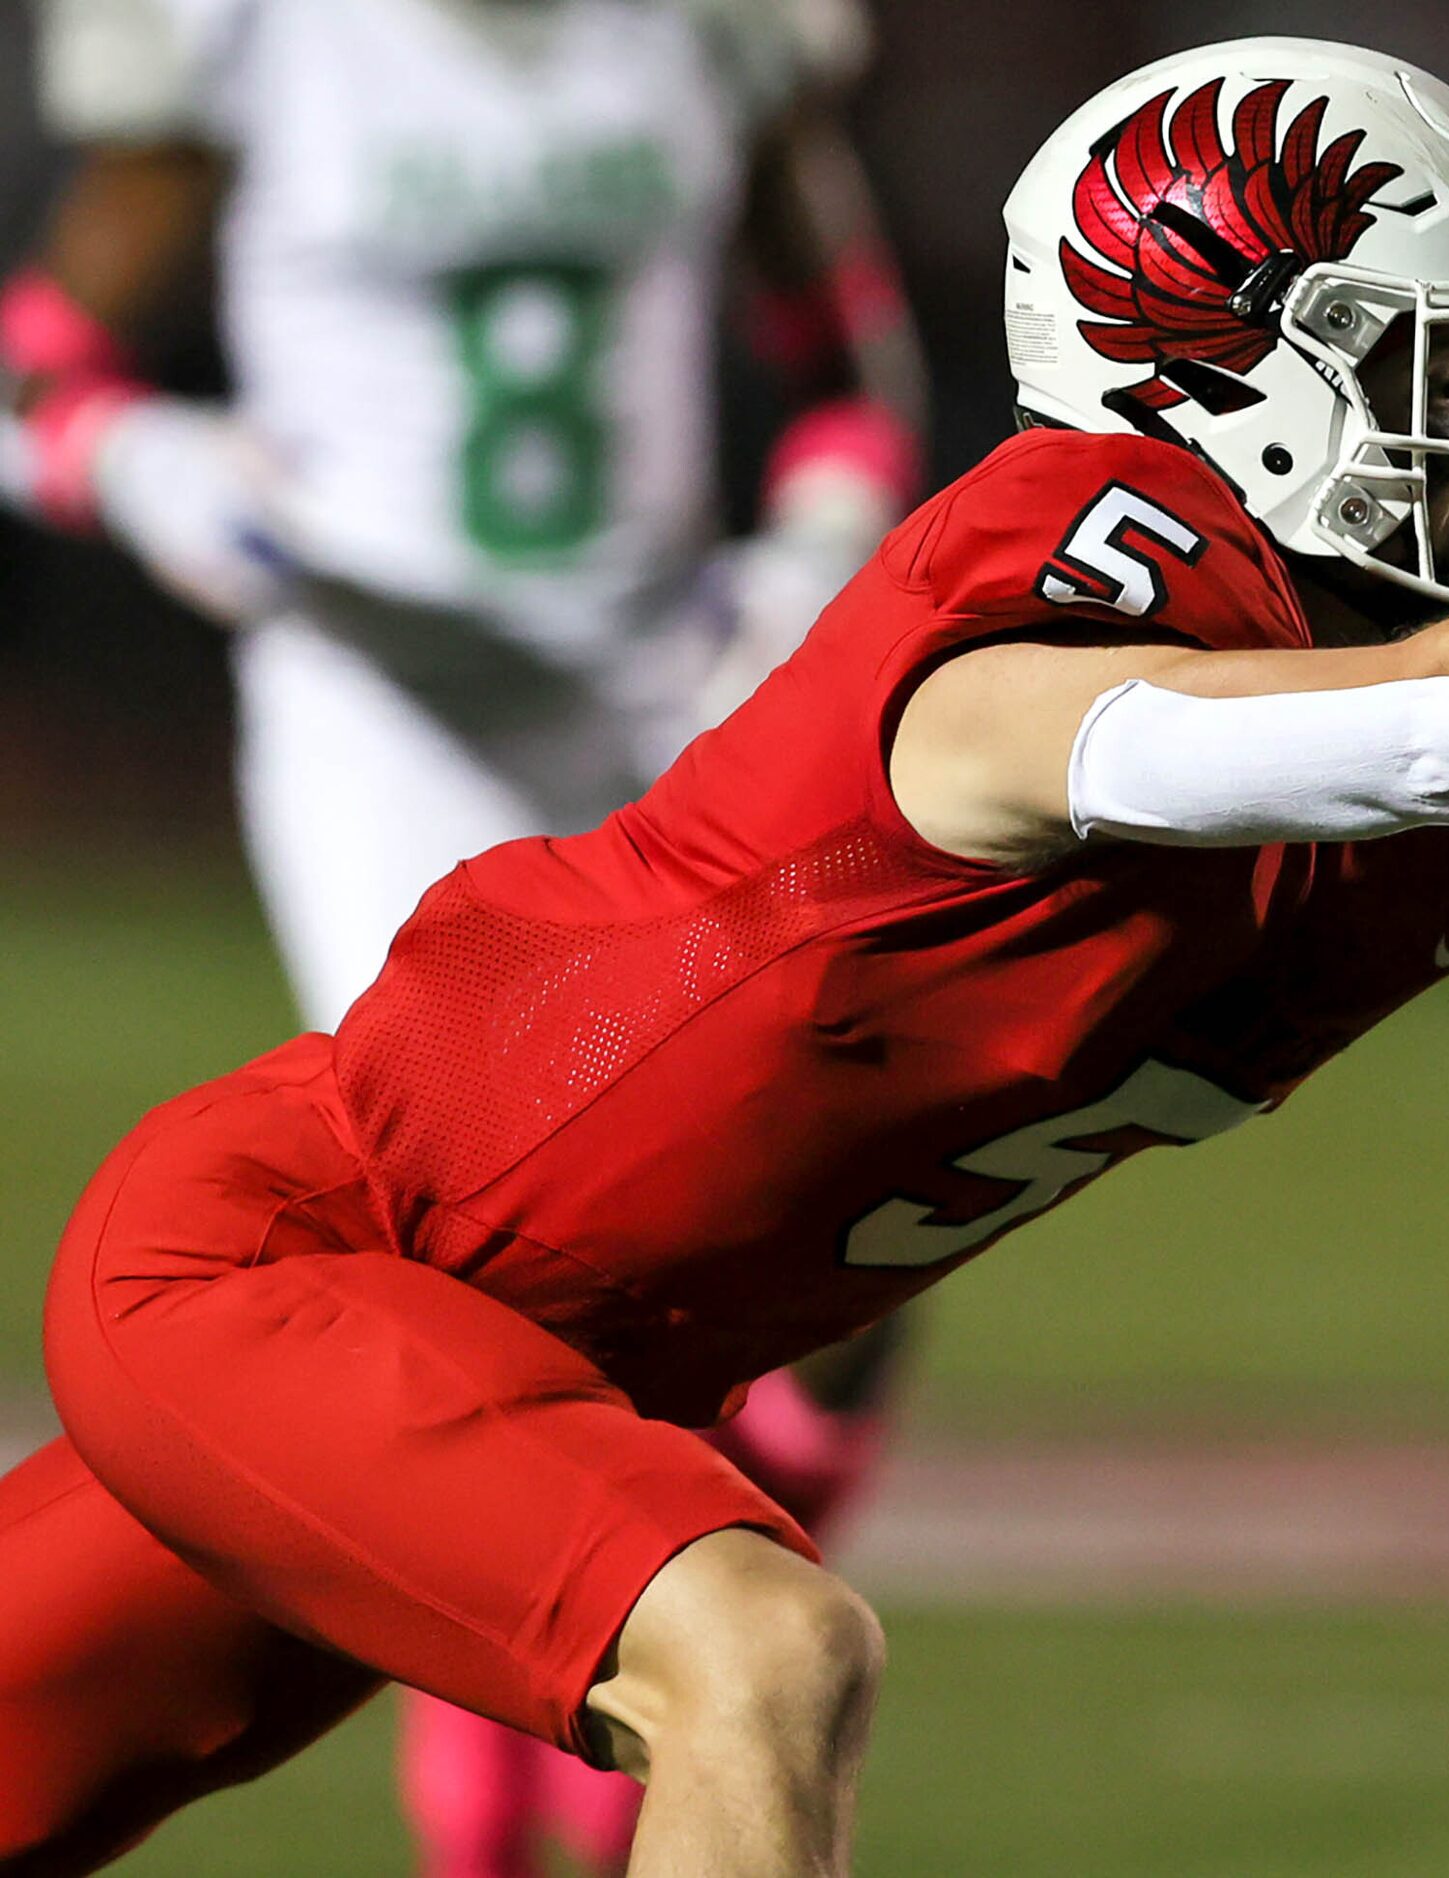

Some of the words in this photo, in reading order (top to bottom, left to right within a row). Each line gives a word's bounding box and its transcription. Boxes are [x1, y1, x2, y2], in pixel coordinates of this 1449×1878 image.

[450, 254, 613, 566] 8
[1036, 480, 1208, 617] 5
[841, 1056, 1272, 1267] 5
